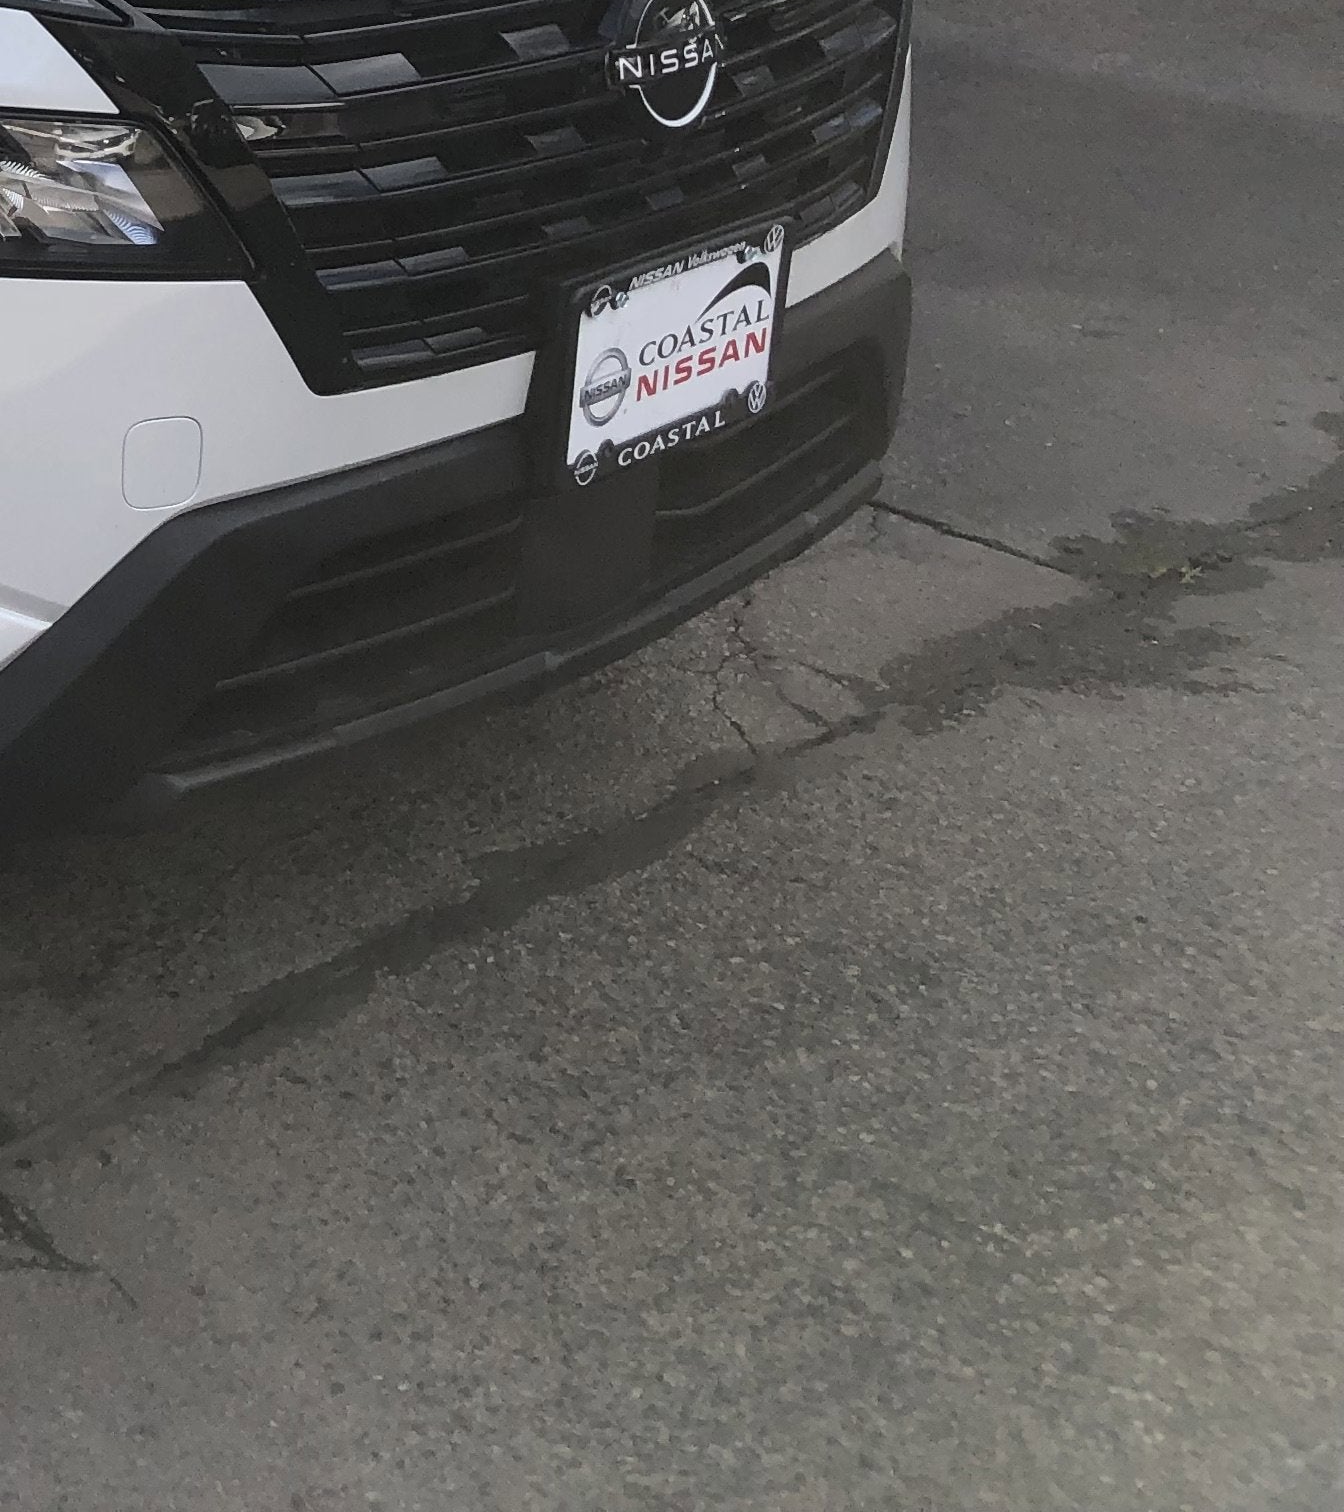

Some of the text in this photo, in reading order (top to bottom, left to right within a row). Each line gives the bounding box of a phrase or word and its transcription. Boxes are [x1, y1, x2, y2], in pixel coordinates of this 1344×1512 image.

[628, 259, 685, 291] NISSAN
[638, 299, 770, 367] COASTAL
[583, 374, 629, 400] NISSAN
[635, 327, 768, 402] NISSAN
[617, 410, 725, 467] COASTAL
